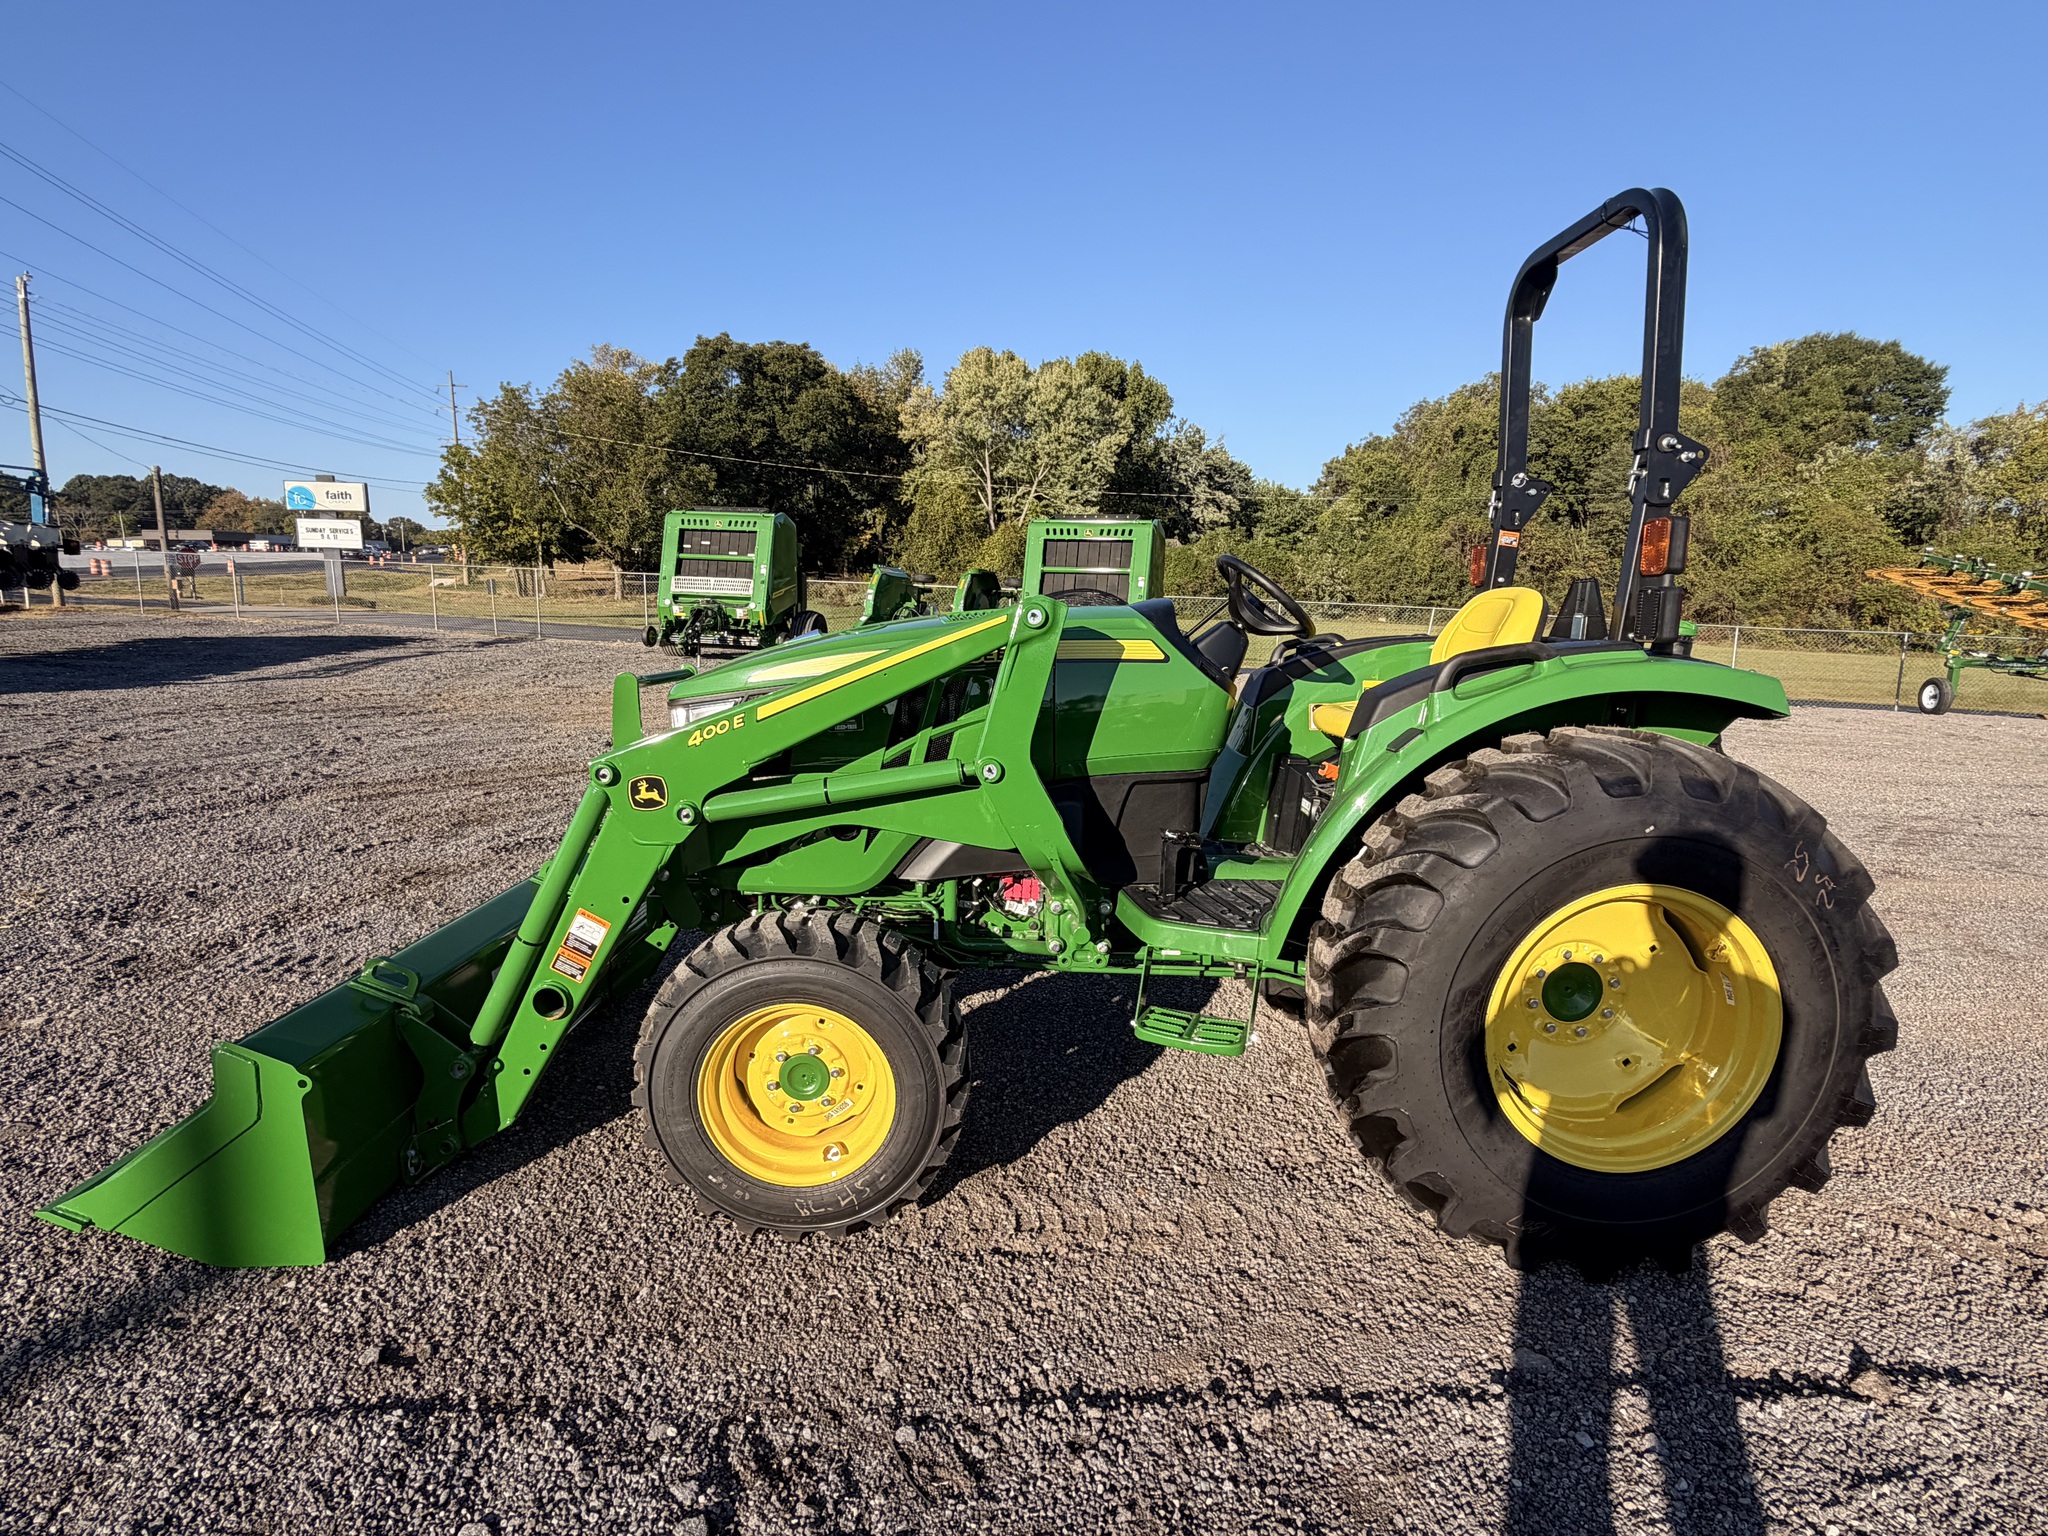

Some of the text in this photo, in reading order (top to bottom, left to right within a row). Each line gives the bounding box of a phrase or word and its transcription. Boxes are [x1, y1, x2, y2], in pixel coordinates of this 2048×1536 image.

[325, 490, 352, 500] faith
[177, 555, 199, 563] STOP
[688, 712, 746, 748] 400 E
